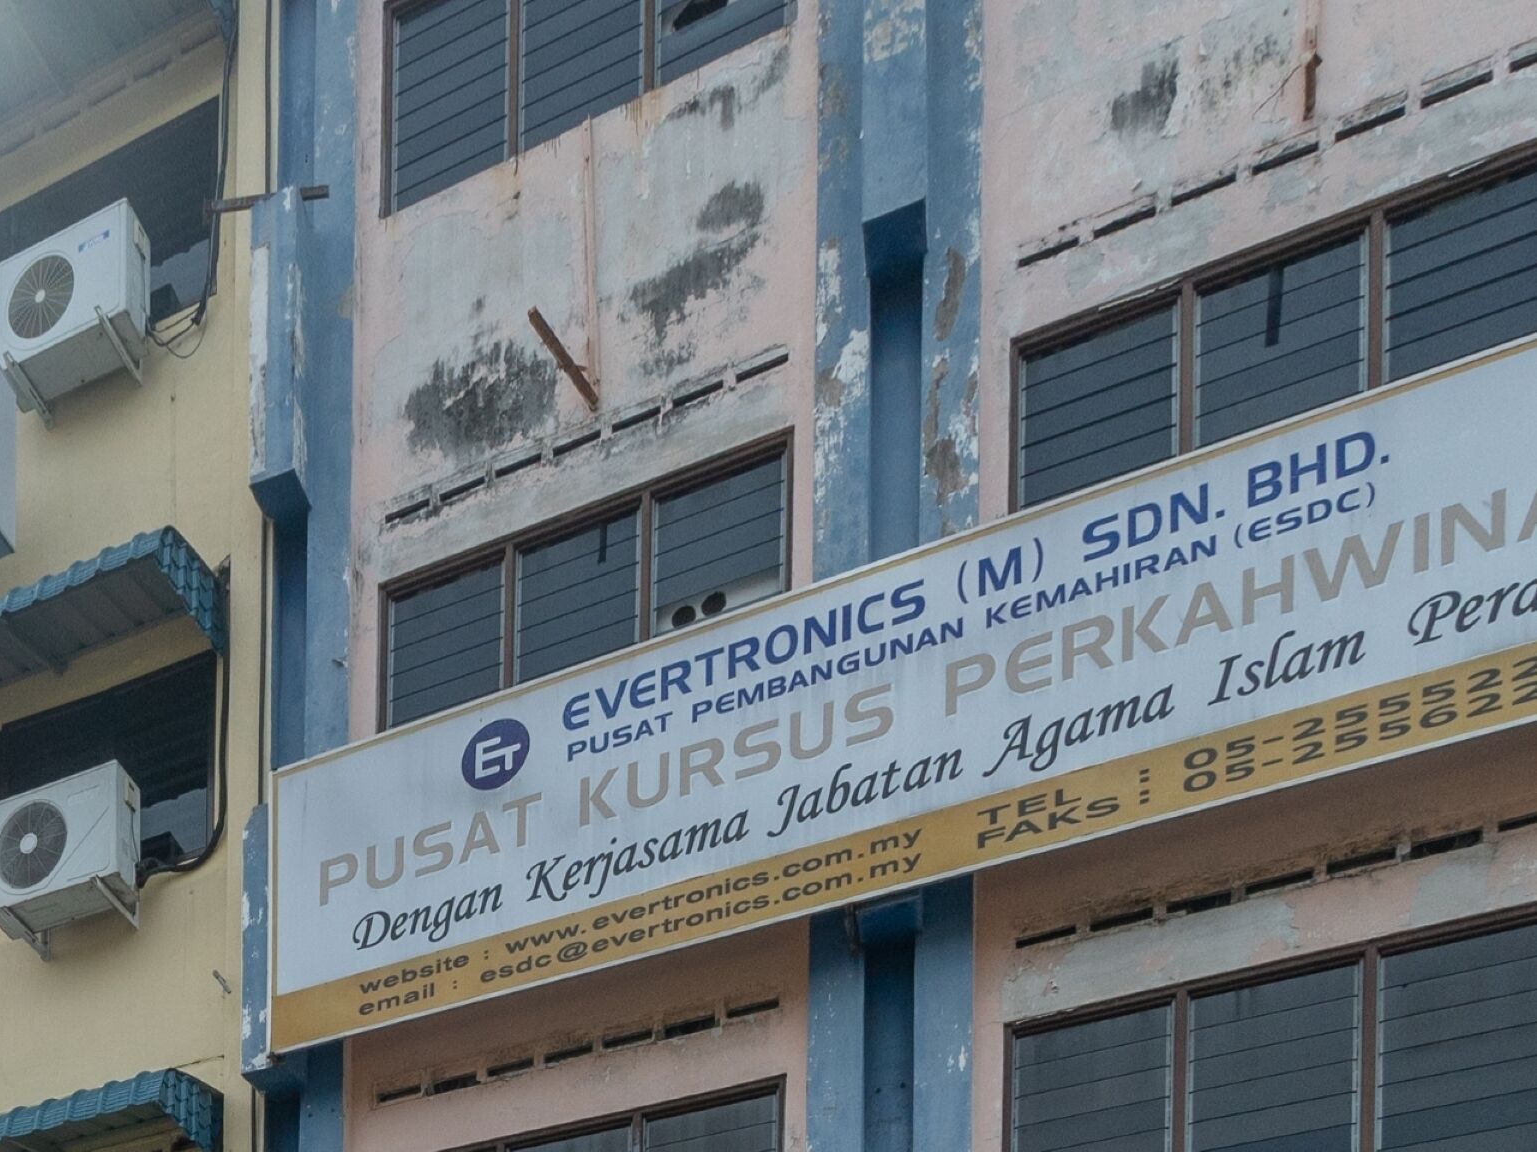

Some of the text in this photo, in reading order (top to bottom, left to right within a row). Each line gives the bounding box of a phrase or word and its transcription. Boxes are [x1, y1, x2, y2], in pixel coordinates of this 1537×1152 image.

[562, 430, 1391, 731] EVERTRONICS (M) SDN. BHD.
[567, 481, 1377, 763] PUSAT PEMBANGUNAN KEMAHIRAN (ESDC)
[318, 792, 543, 906] PUSAT
[580, 683, 895, 828] KURSUS
[352, 883, 504, 951] Dengan
[525, 808, 750, 904] Kerjasama
[767, 749, 964, 838] Jabatan
[982, 683, 1176, 779] Agama
[1207, 629, 1367, 707] Islam
[358, 982, 436, 1018] email
[479, 851, 923, 984] esdc@evertronics.com.my
[977, 797, 1121, 850] FAKS
[359, 951, 471, 995] website
[505, 826, 924, 954] www.evertronics.com.my
[977, 788, 1082, 825] TEL
